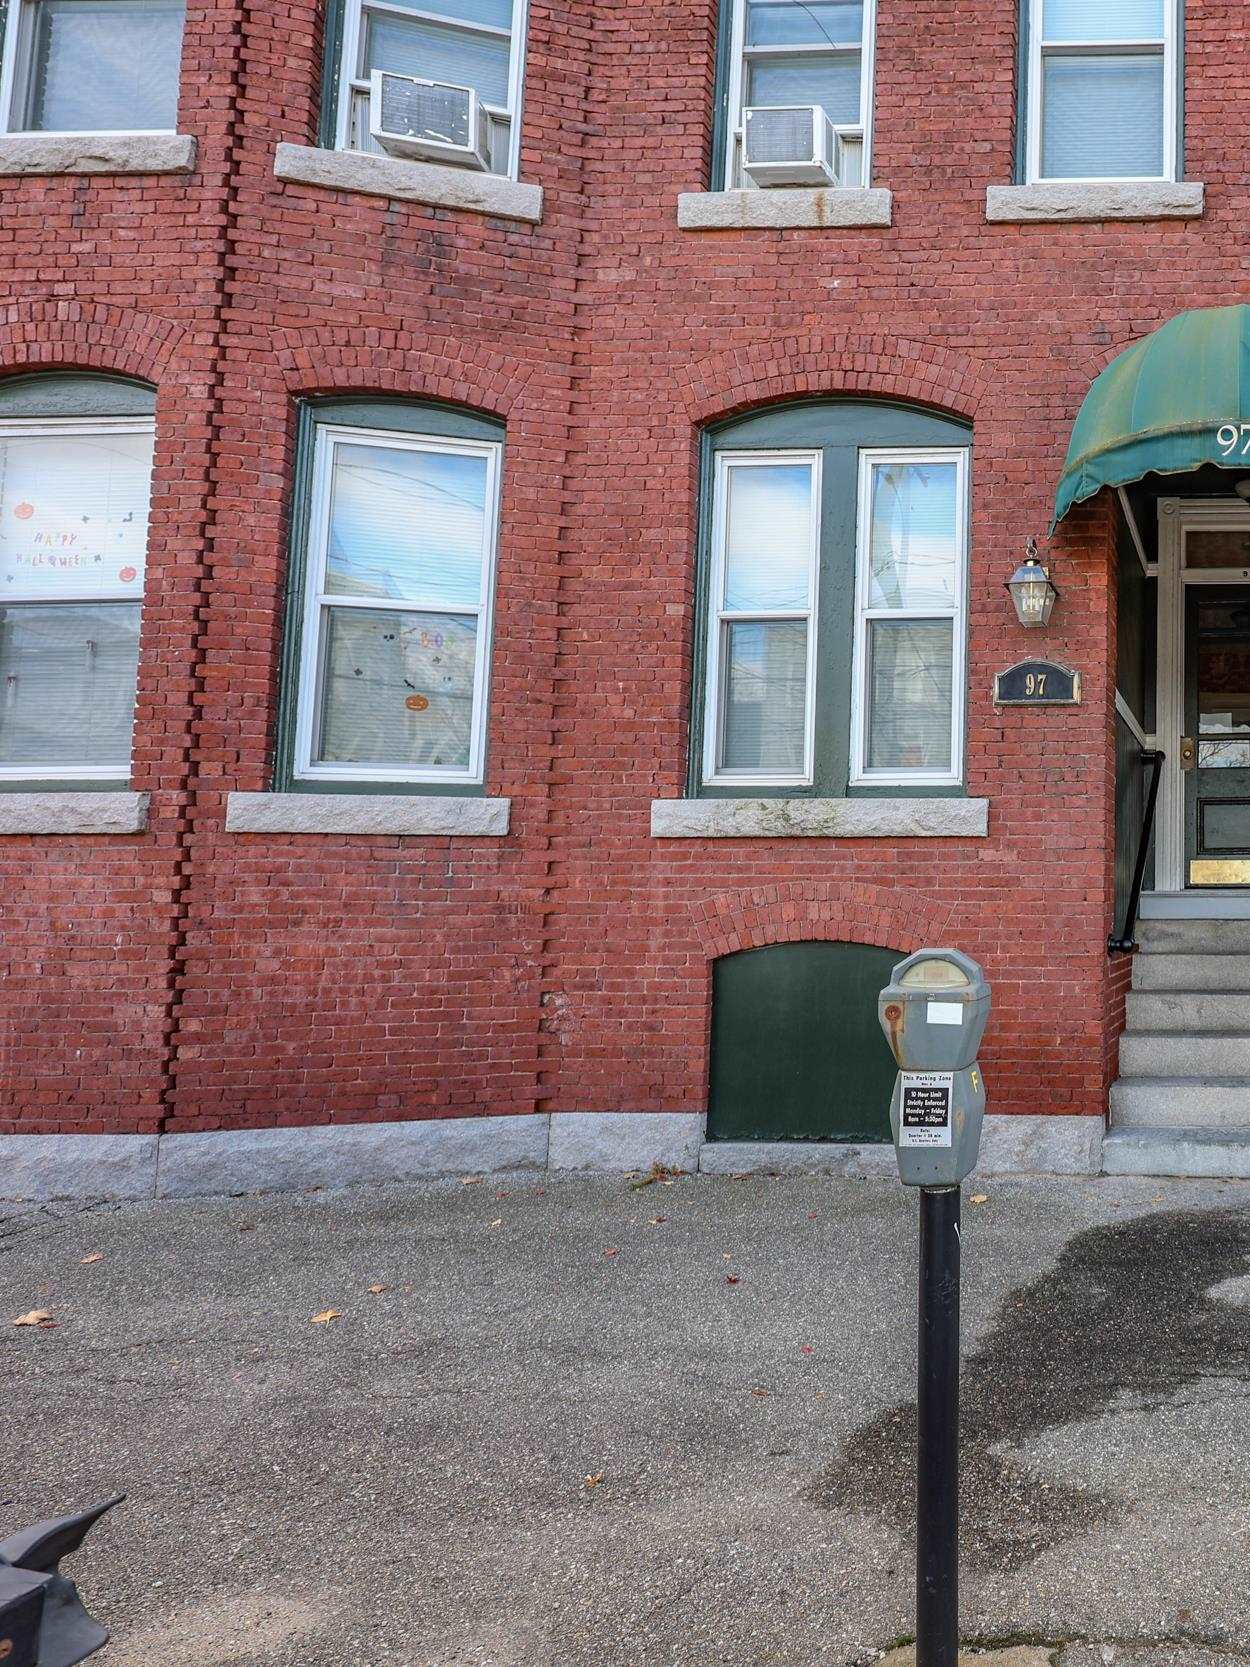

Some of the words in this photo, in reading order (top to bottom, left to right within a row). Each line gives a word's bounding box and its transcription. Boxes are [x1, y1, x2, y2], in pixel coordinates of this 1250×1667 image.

[33, 528, 78, 546] HAPPY
[16, 552, 88, 568] HALLOWEEN
[1026, 674, 1046, 695] 97
